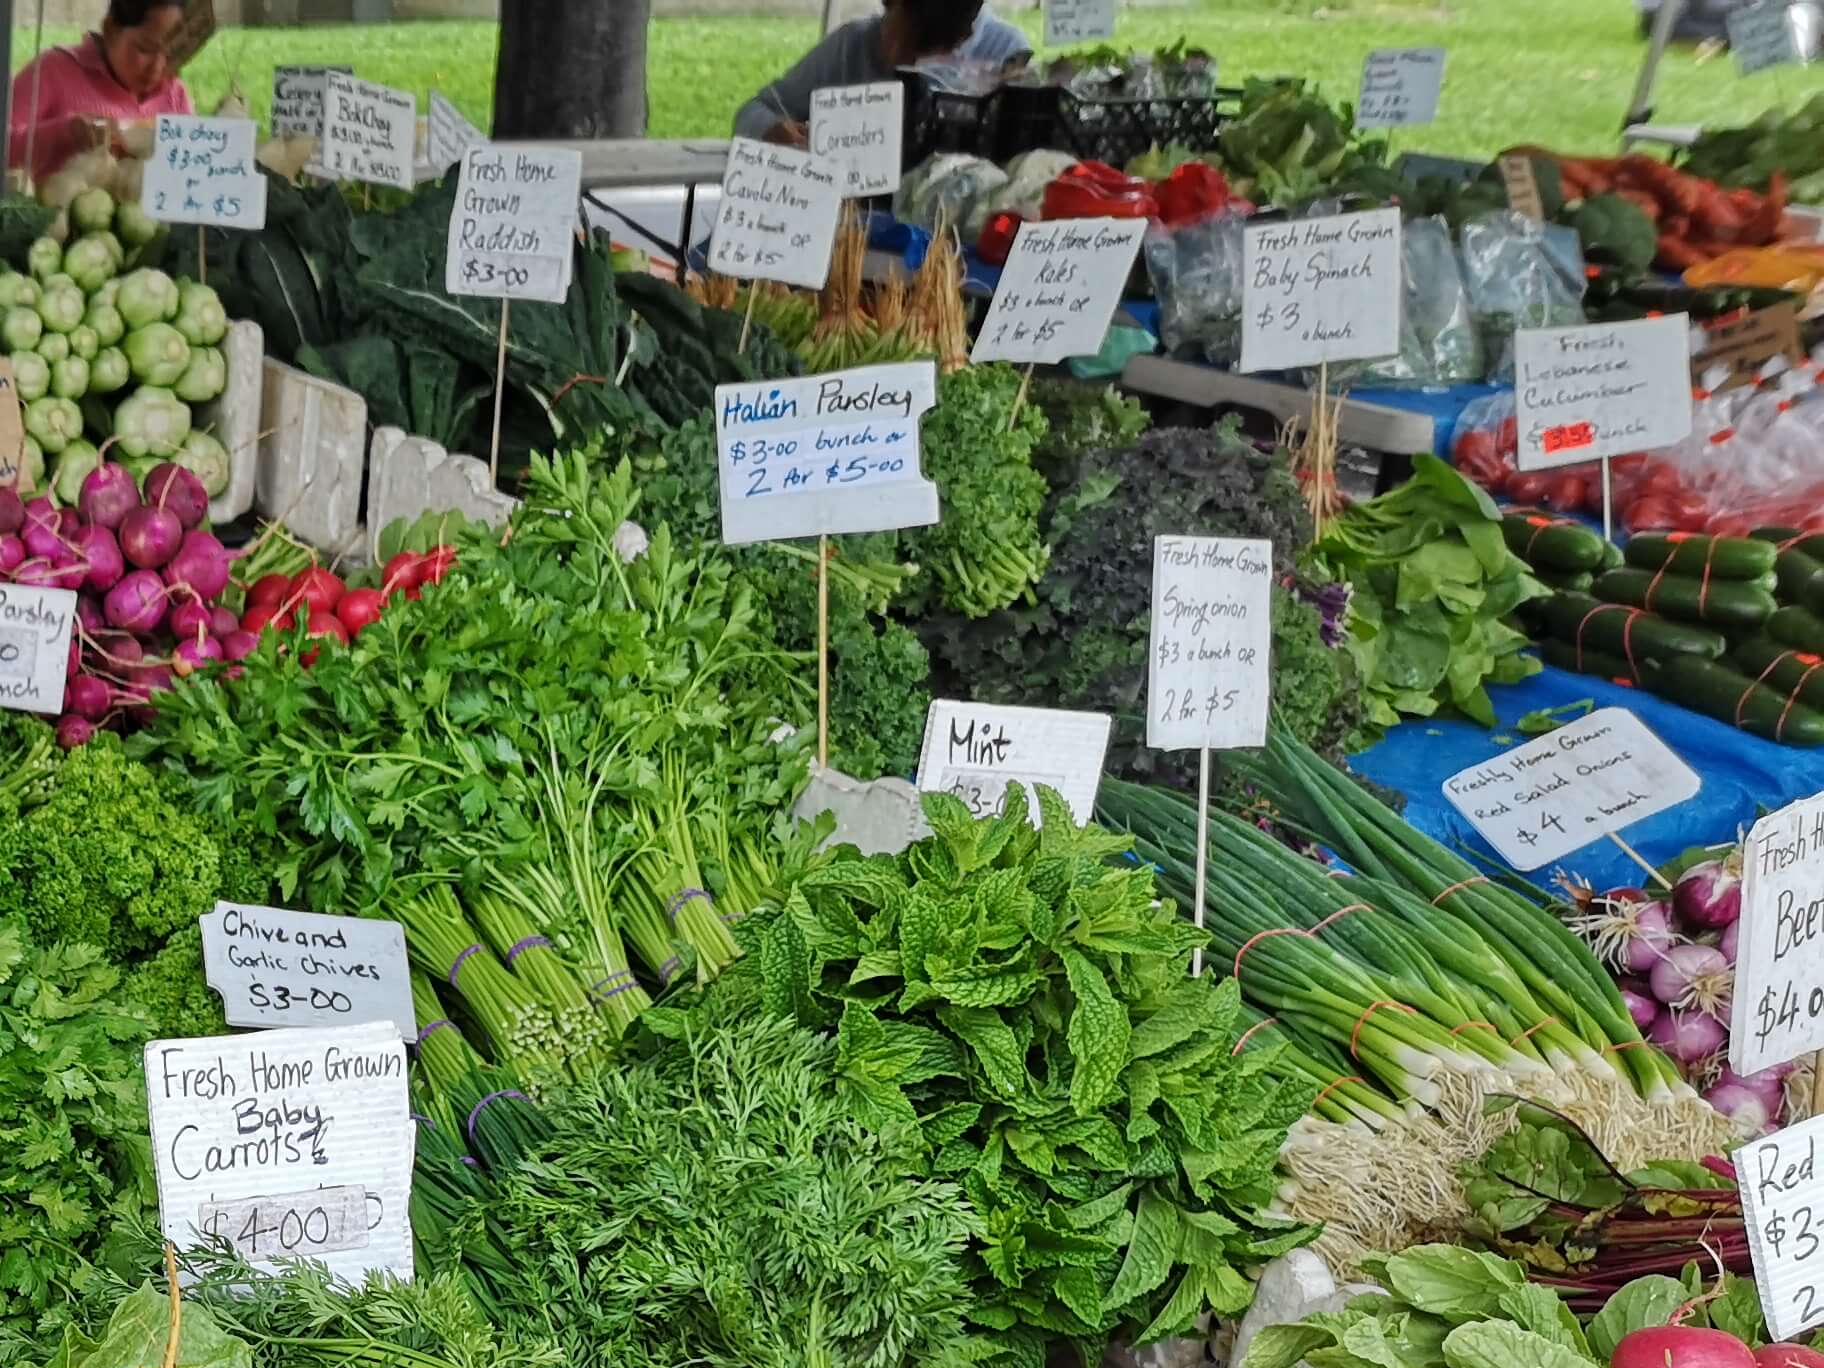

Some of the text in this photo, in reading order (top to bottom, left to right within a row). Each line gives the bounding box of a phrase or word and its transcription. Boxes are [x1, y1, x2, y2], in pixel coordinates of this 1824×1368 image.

[468, 150, 557, 184] Fresh Home
[726, 170, 773, 203] Cavolo
[464, 187, 521, 216] Grown
[459, 218, 540, 252] Raddish
[1021, 226, 1060, 255] Fresh
[1056, 225, 1094, 253] Home
[1256, 225, 1299, 251] Fresh
[1303, 222, 1344, 246] Home
[1033, 257, 1078, 285] Kales
[1253, 251, 1373, 297] Baby Spinach
[816, 379, 913, 418] Parsley
[729, 439, 798, 467] $3-00
[814, 425, 879, 452] bunch
[744, 457, 904, 498] 2 for $5-00
[1162, 541, 1200, 569] Fresh
[1202, 541, 1235, 570] Home
[1163, 584, 1248, 636] Spring onion
[1158, 635, 1180, 669] $3
[1198, 637, 1231, 661] bunch
[1161, 688, 1240, 726] 2 for $5
[949, 716, 1012, 768] Mint
[1448, 768, 1514, 796] Freshly
[1513, 748, 1557, 773] Home
[1474, 750, 1633, 820] Red Salad Onions
[1599, 790, 1651, 817] bunch
[1758, 815, 1806, 876] Fresh
[223, 909, 347, 950] Chive and
[228, 944, 288, 972] Garlic
[161, 1046, 401, 1099] Fresh Home Grown
[232, 1097, 334, 1142] Baby
[171, 1124, 301, 1181] Carrots
[1758, 1135, 1816, 1207] Red
